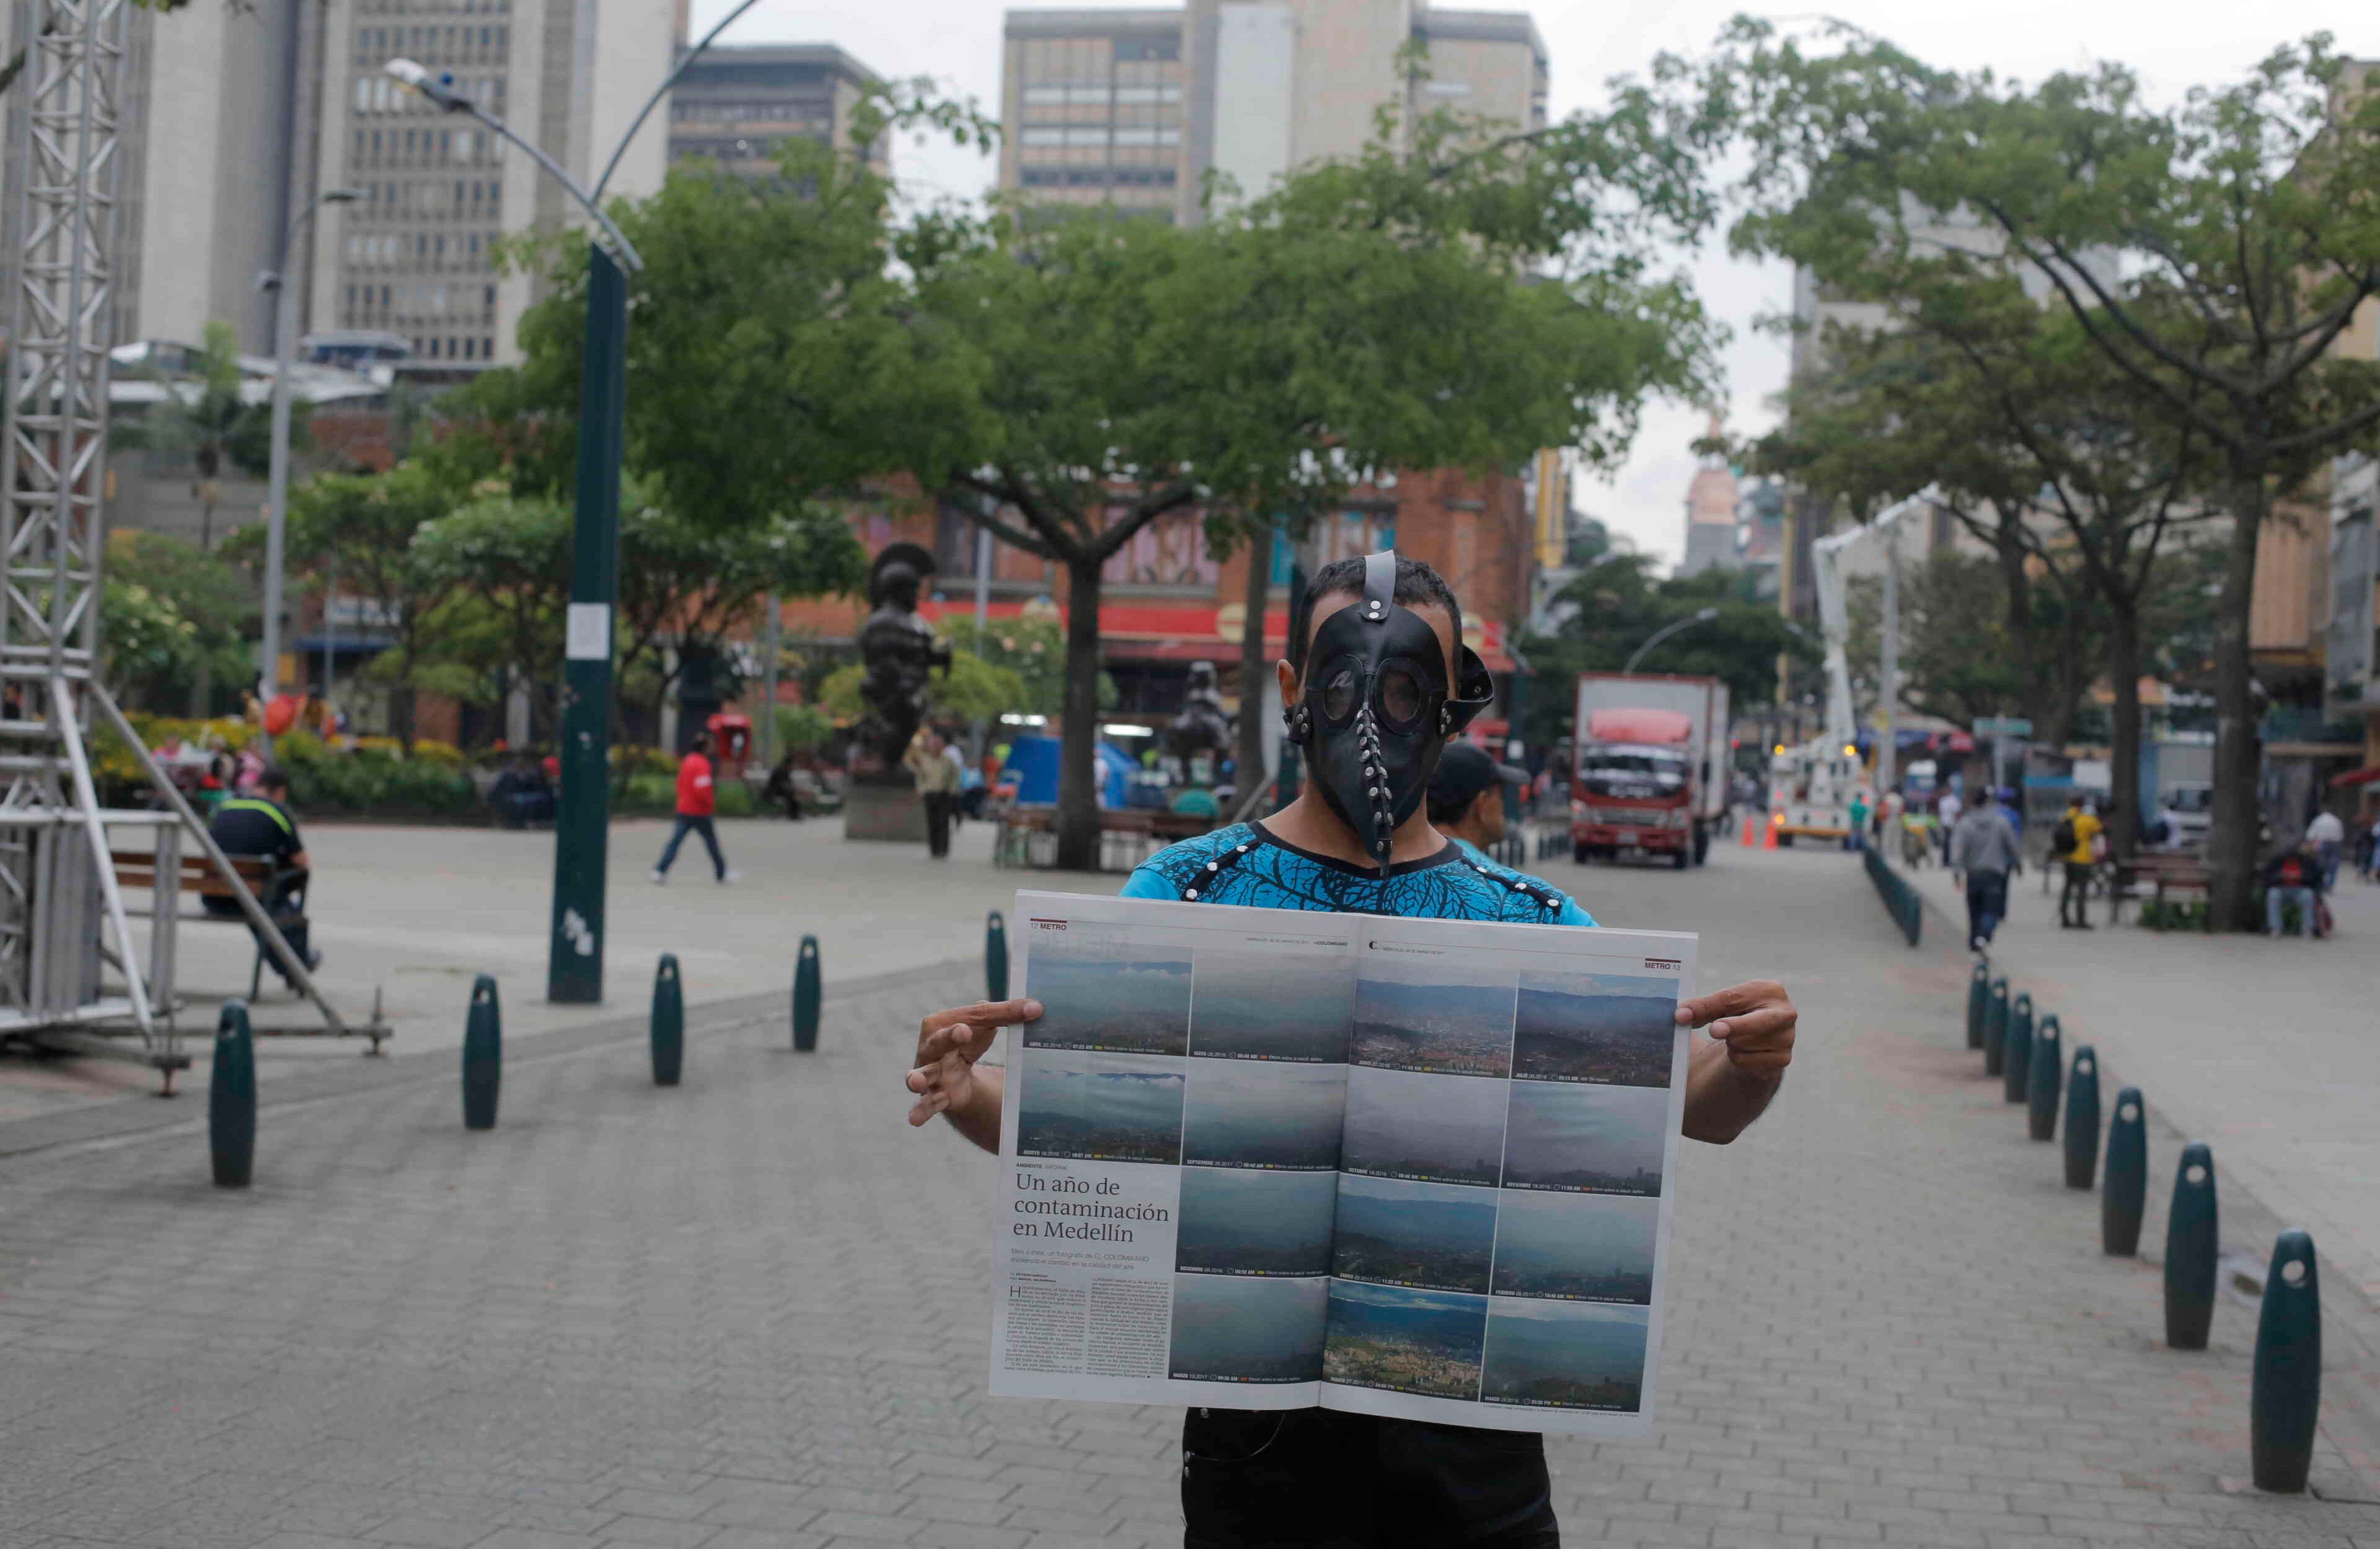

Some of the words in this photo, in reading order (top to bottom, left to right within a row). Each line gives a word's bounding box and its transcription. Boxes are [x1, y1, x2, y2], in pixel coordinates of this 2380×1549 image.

[1016, 1173, 1046, 1191] Un
[1052, 1175, 1090, 1193] año
[1096, 1177, 1120, 1195] de
[1014, 1200, 1170, 1221] contaminación
[1013, 1222, 1038, 1236] en
[1044, 1221, 1134, 1242] Medellín
[1103, 1253, 1150, 1262] COLOMBIANO
